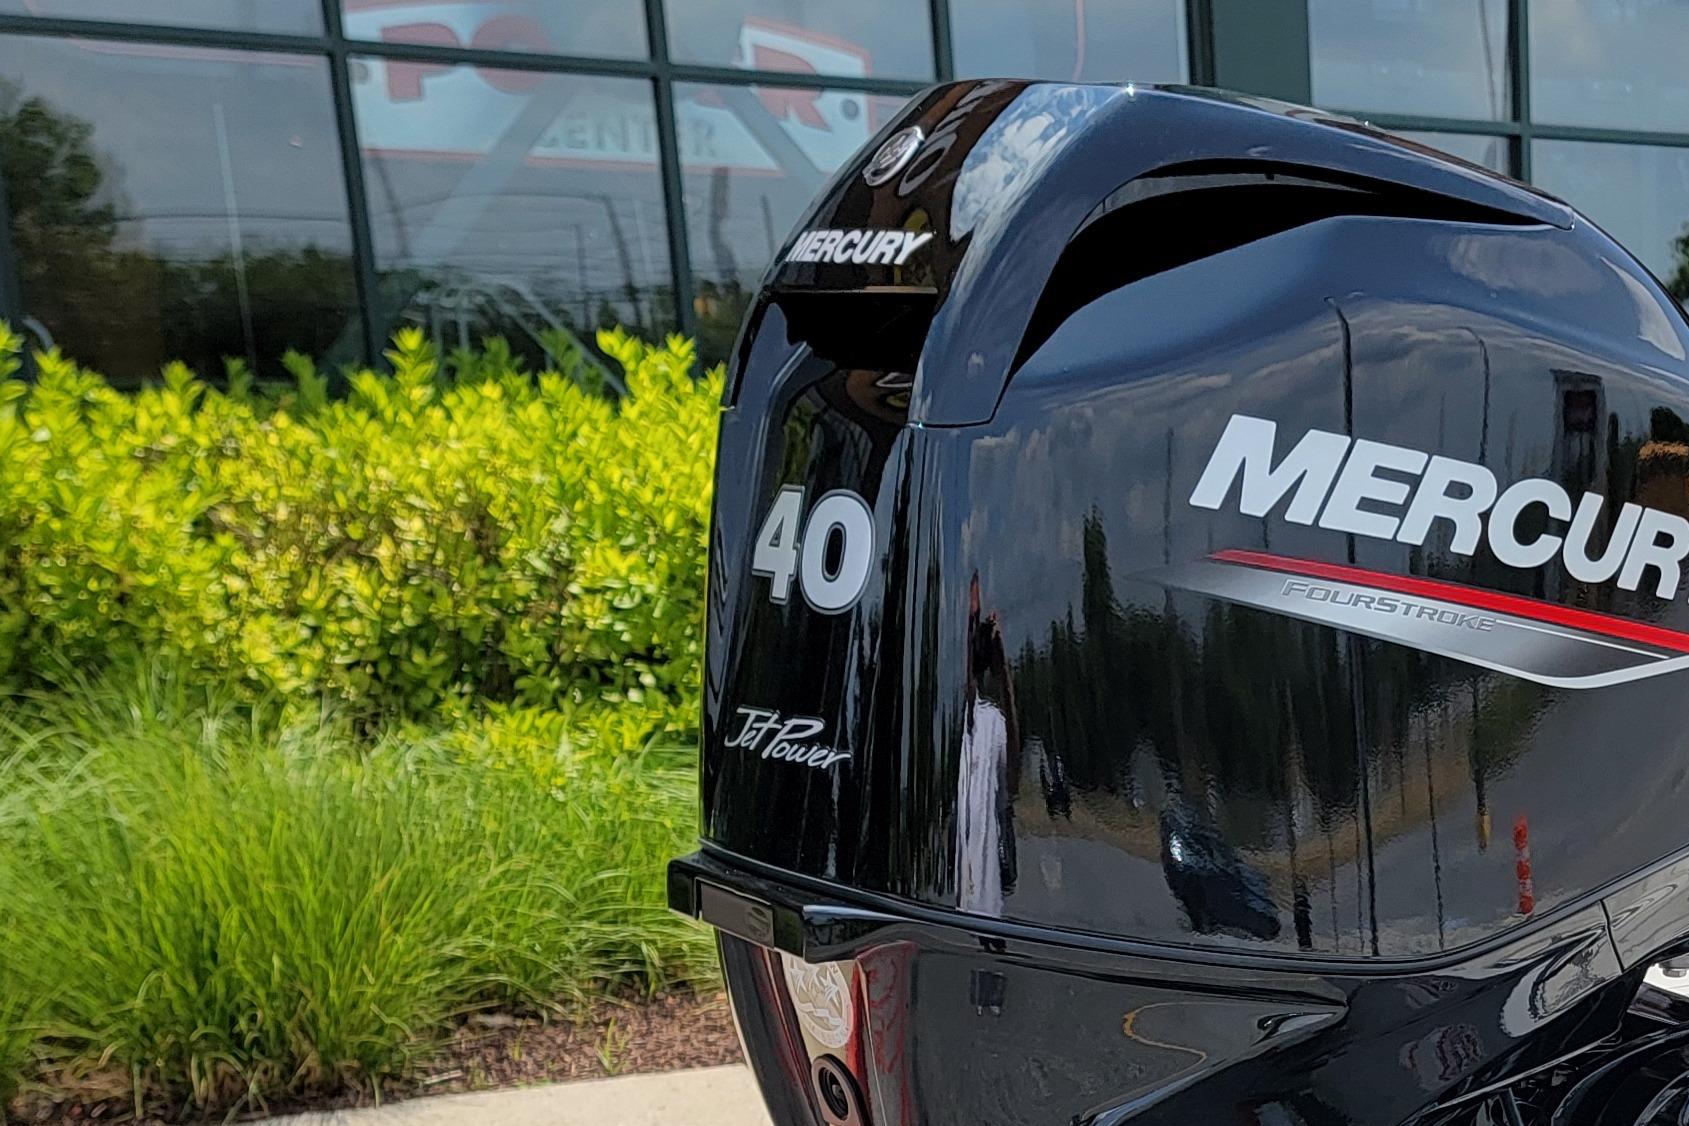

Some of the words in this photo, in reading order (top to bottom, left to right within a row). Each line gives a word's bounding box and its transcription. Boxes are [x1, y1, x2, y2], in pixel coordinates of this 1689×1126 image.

[785, 229, 933, 265] MERCURY
[751, 483, 876, 615] 40
[1281, 577, 1499, 633] FOURSTROKE
